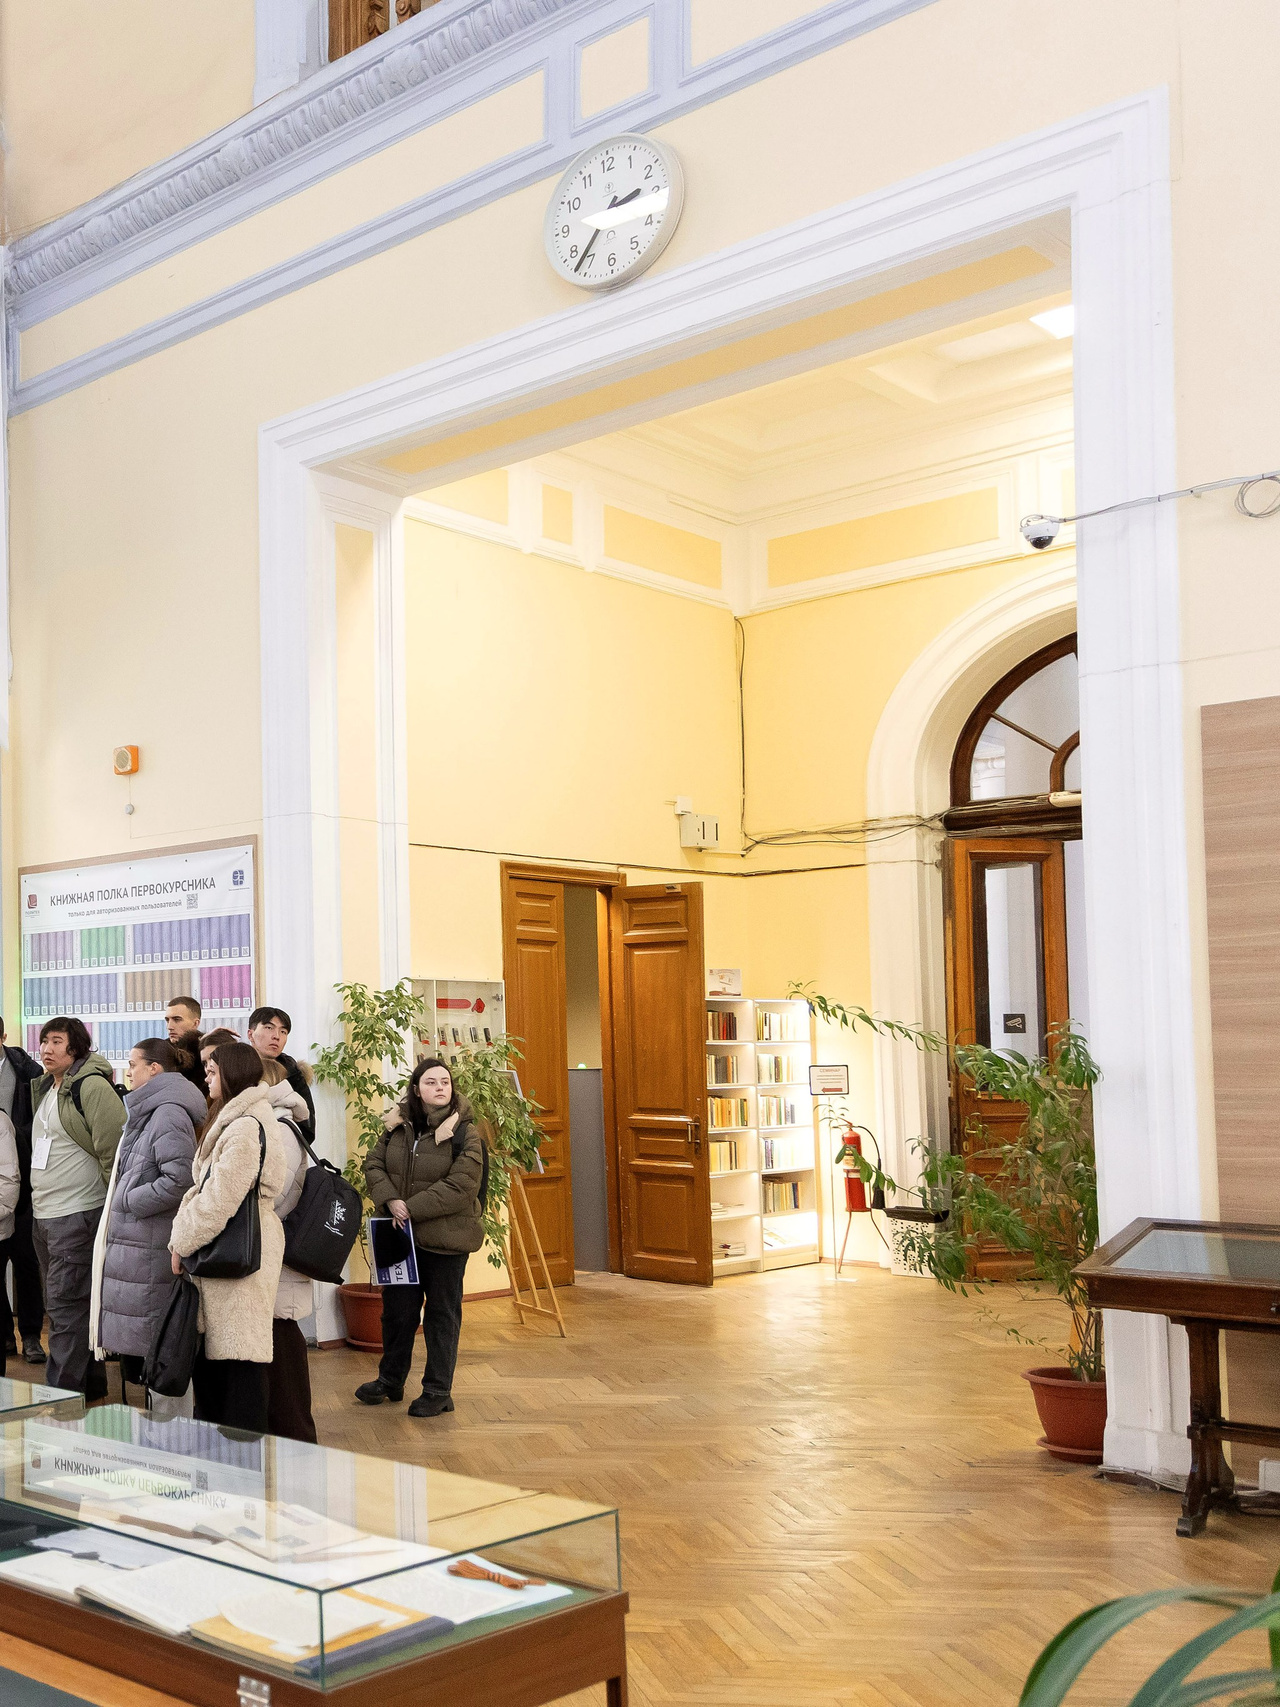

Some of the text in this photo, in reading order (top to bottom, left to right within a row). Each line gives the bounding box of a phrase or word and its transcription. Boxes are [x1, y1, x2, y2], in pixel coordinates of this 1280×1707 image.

[601, 156, 615, 173] 12
[627, 155, 632, 169] 1
[643, 164, 653, 180] 2
[582, 173, 592, 189] 11
[567, 196, 581, 214] 10
[644, 213, 654, 227] 4
[561, 224, 570, 238] 9
[630, 235, 639, 250] 5
[569, 244, 579, 258] 8
[587, 253, 596, 269] 7
[607, 252, 617, 267] 6
[50, 877, 216, 907] КНИЖНАЯ ПОЛКА ПЕРВОКУРСНИКА
[85, 909, 96, 917] для
[97, 904, 140, 914] авторизованных
[140, 899, 183, 910] пользователей
